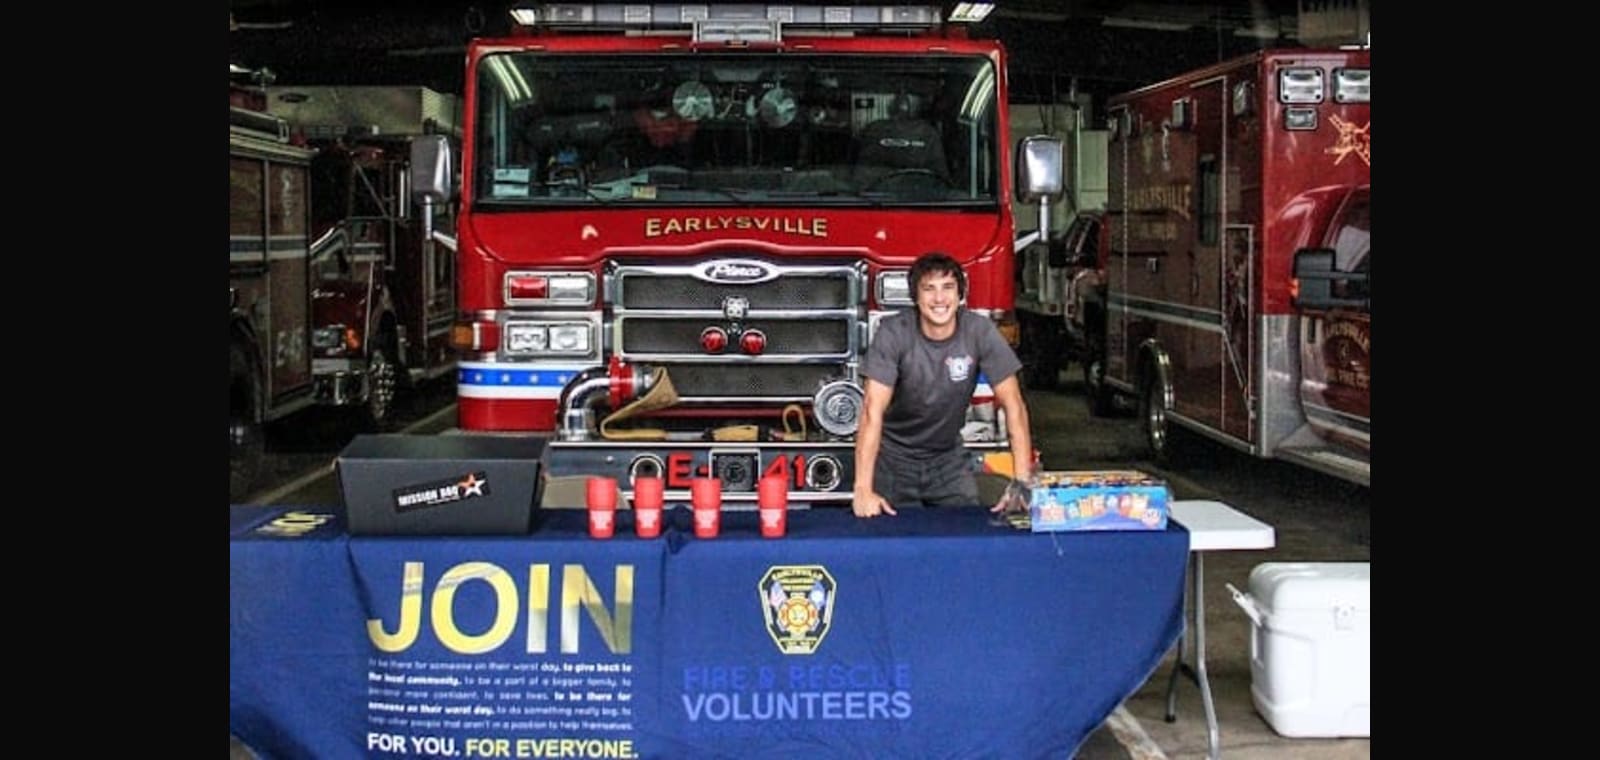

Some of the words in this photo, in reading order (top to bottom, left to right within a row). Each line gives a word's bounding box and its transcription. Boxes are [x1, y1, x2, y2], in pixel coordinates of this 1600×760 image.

[645, 216, 828, 237] EARLYSVILLE
[366, 561, 634, 654] JOIN
[681, 691, 913, 722] VOLUNTEERS
[367, 733, 406, 751] FOR
[411, 736, 460, 756] YOU.
[466, 738, 511, 757] FOR
[516, 739, 639, 759] EVERYONE.
